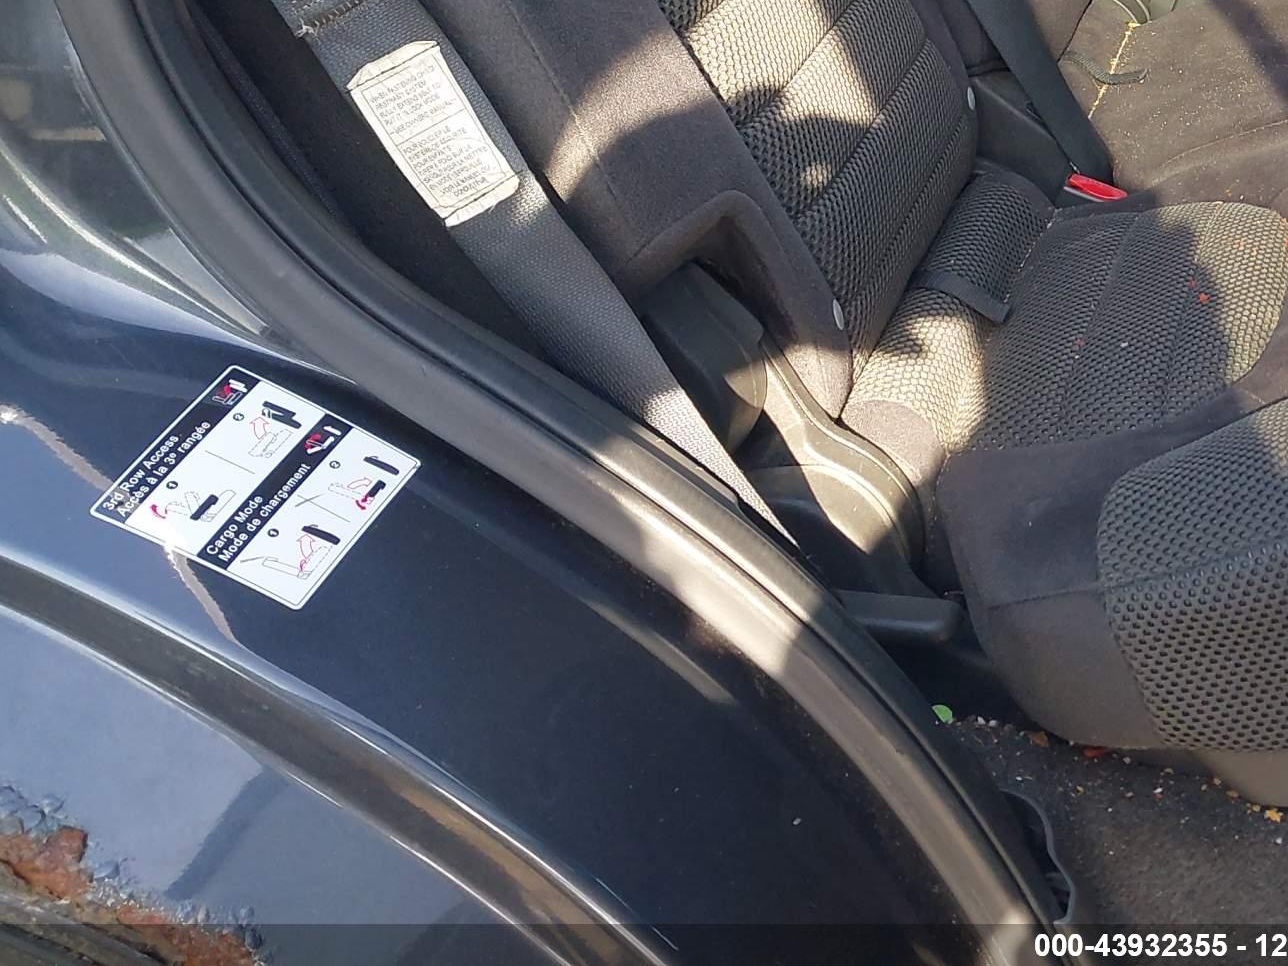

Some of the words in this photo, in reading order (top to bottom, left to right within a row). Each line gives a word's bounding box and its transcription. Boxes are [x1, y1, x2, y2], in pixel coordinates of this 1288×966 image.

[103, 491, 124, 511] 3rd
[120, 469, 146, 494] Row
[142, 435, 179, 469] Access
[117, 485, 149, 517] Accès
[145, 475, 158, 485] à
[153, 466, 168, 477] la
[176, 421, 211, 454] rangée
[205, 523, 238, 555] Cargo
[233, 495, 263, 524] Mode
[218, 532, 248, 562] Mode
[246, 518, 262, 532] de
[259, 463, 311, 518] chargement
